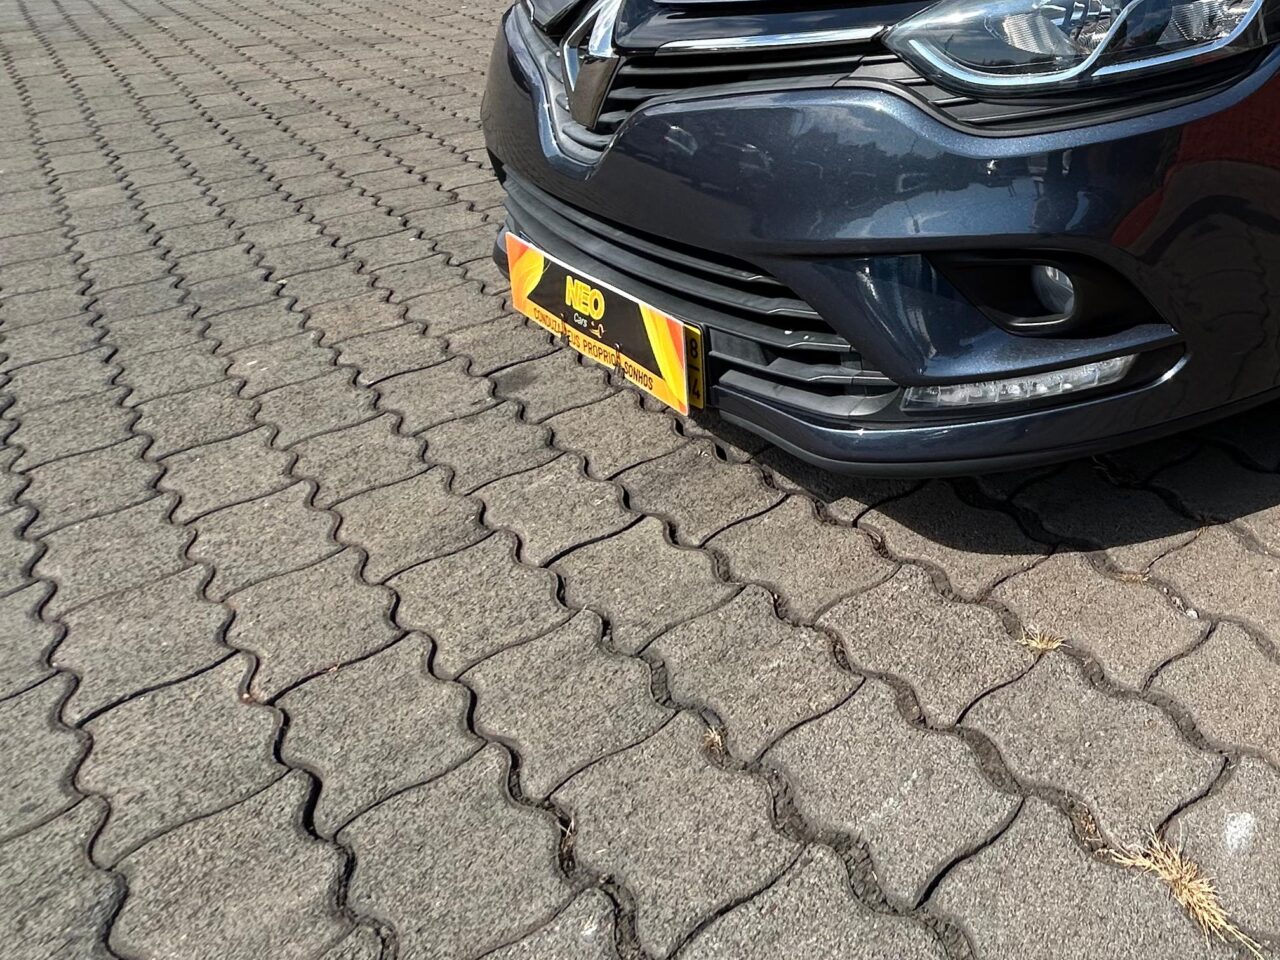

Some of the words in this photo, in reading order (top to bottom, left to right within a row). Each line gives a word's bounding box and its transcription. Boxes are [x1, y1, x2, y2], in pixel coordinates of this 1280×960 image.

[565, 275, 605, 321] NEO
[573, 312, 588, 328] Cars
[624, 361, 653, 390] SONHOS
